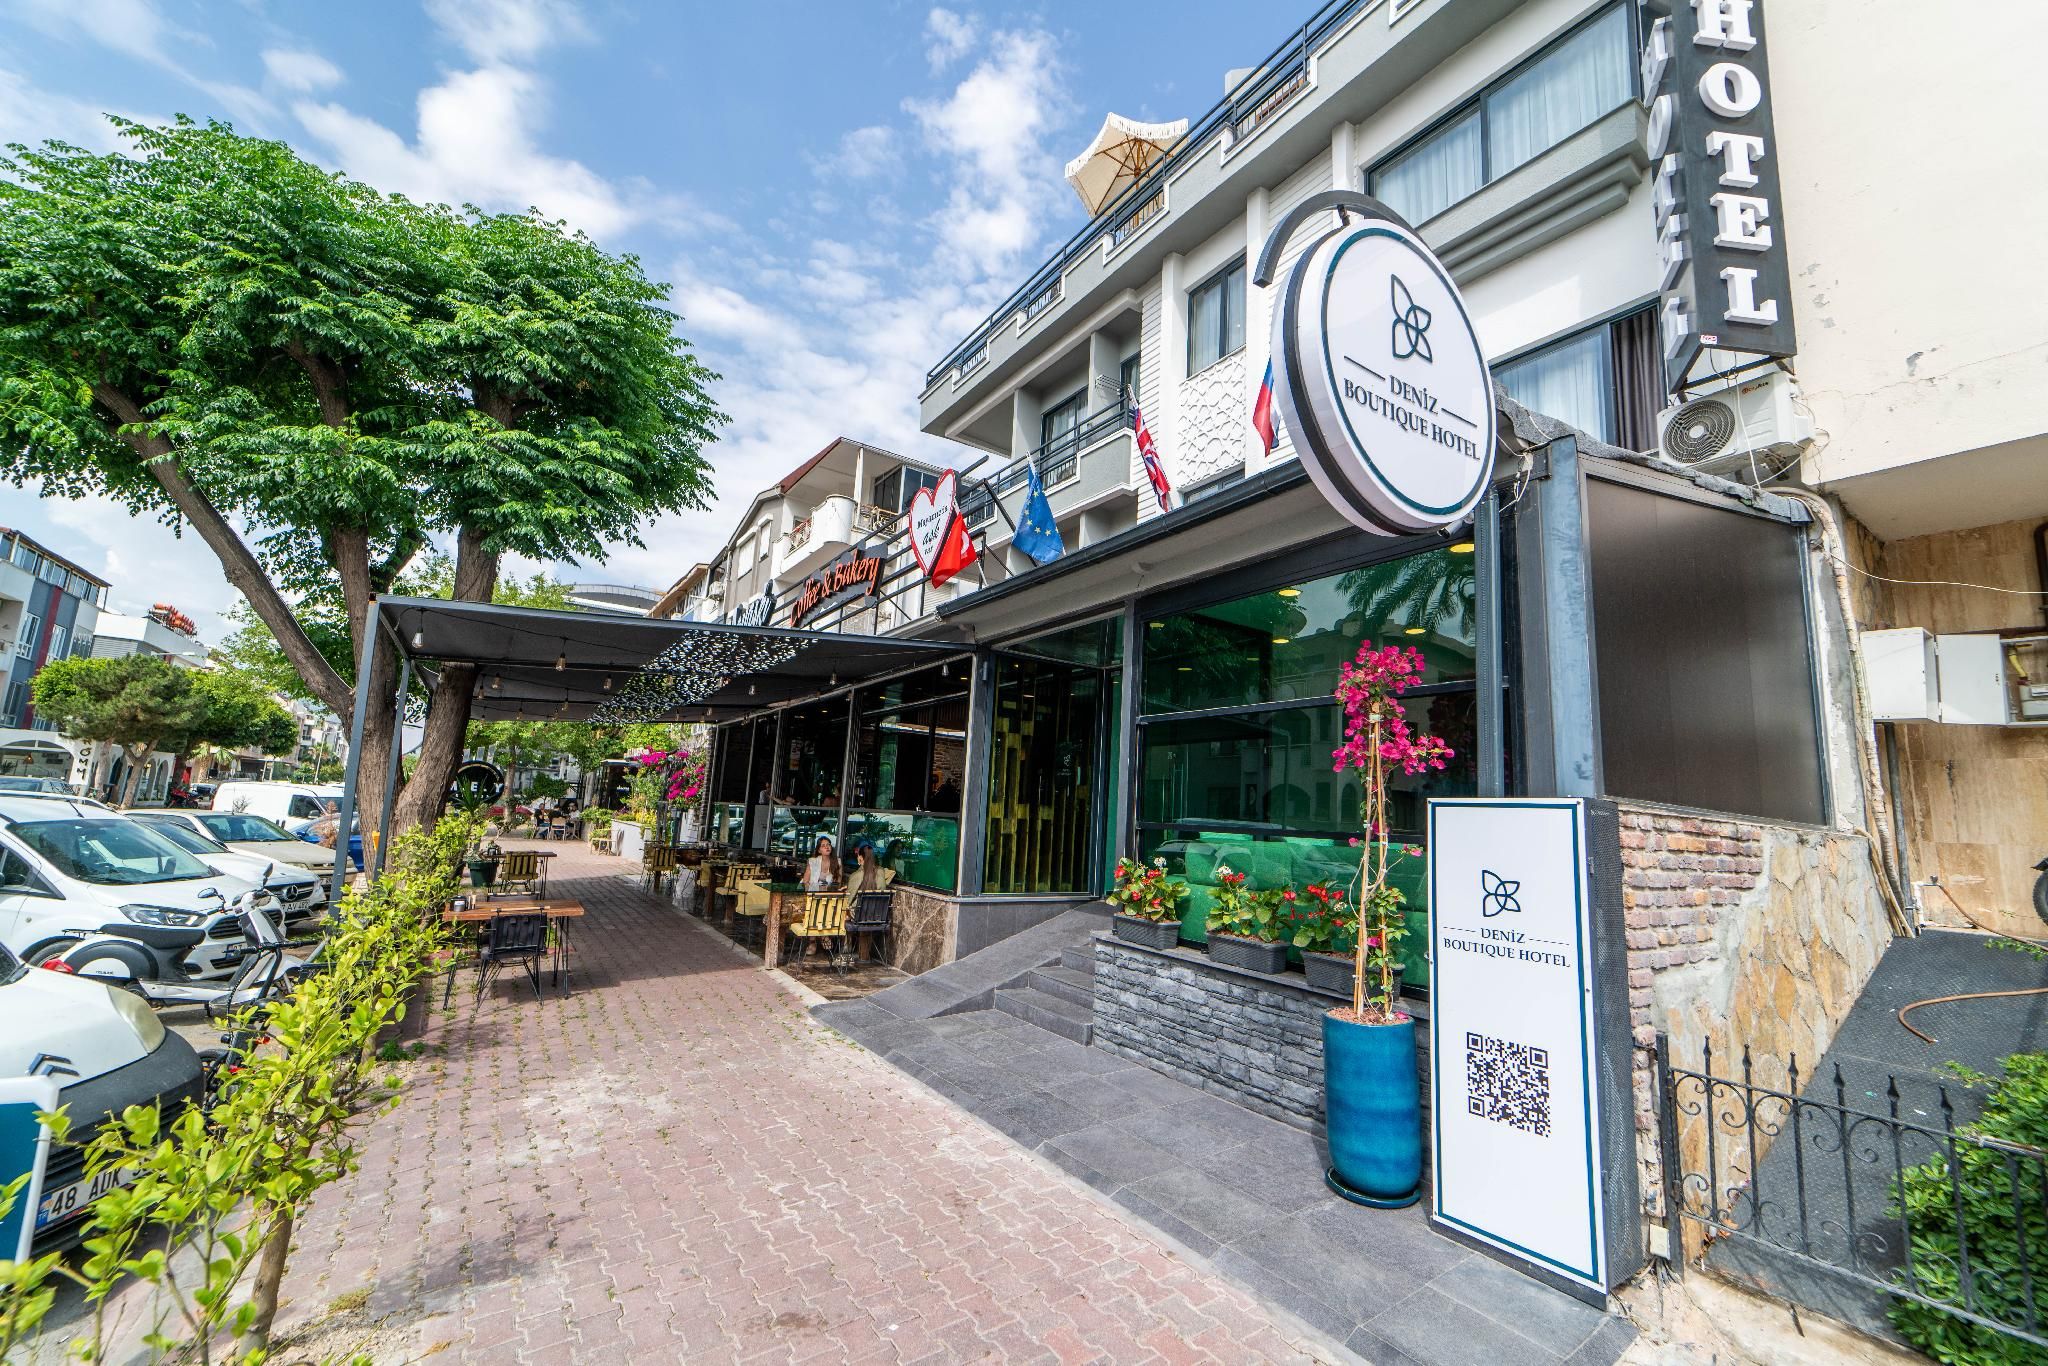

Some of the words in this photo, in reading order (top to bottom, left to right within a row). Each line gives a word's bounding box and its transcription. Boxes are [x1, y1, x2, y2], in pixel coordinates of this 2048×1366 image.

[1689, 0, 1778, 326] HOTEL
[1389, 374, 1439, 415] DENİZ
[1343, 377, 1429, 437] BOUTIQUE
[1431, 423, 1481, 461] HOTEL
[789, 577, 821, 628] Coffee
[821, 569, 833, 598] &
[833, 547, 881, 597] Bakery
[1444, 938, 1515, 958] BOUTIQUE
[1519, 949, 1570, 967] HOTEL
[1480, 928, 1525, 943] DENİZ
[51, 1186, 77, 1216] 48
